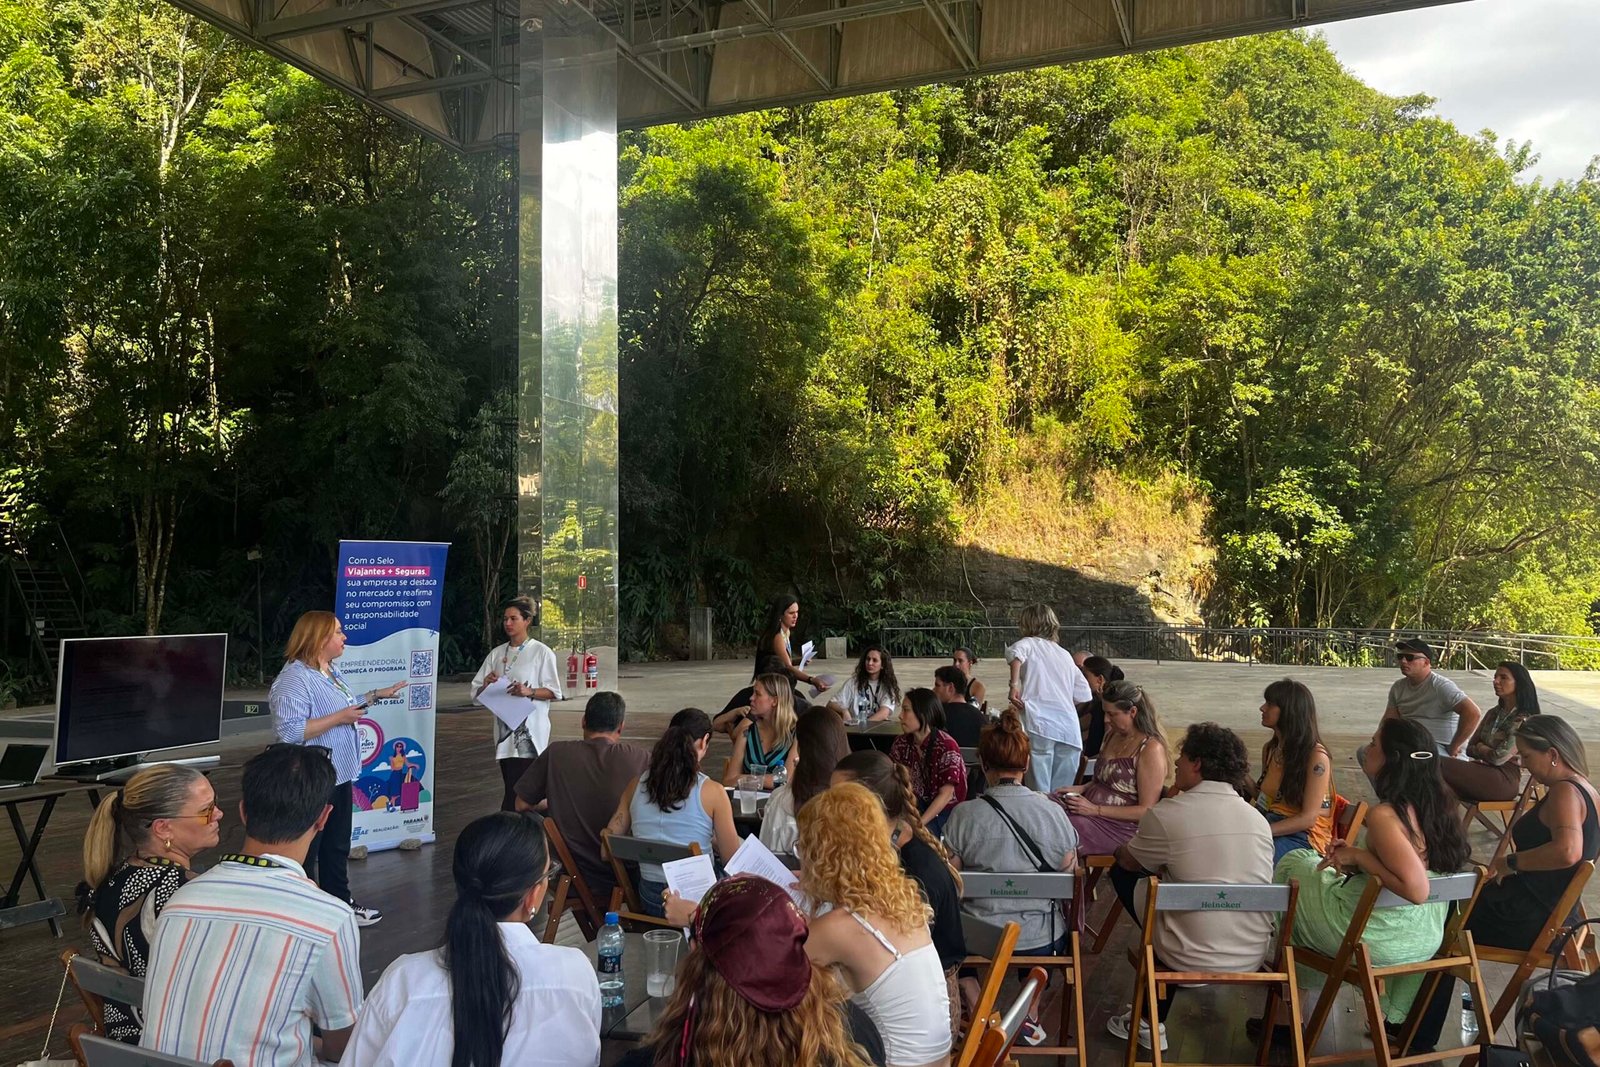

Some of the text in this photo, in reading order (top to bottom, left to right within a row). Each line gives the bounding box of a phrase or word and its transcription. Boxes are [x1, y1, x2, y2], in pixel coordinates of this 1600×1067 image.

[348, 556, 367, 564] Com
[377, 556, 394, 564] Selo
[348, 568, 386, 577] Viajantes
[359, 589, 394, 597] mercado
[403, 588, 432, 596] reafirma
[362, 600, 415, 609] compromisso
[352, 610, 419, 620] responsabilidade
[344, 622, 367, 630] social
